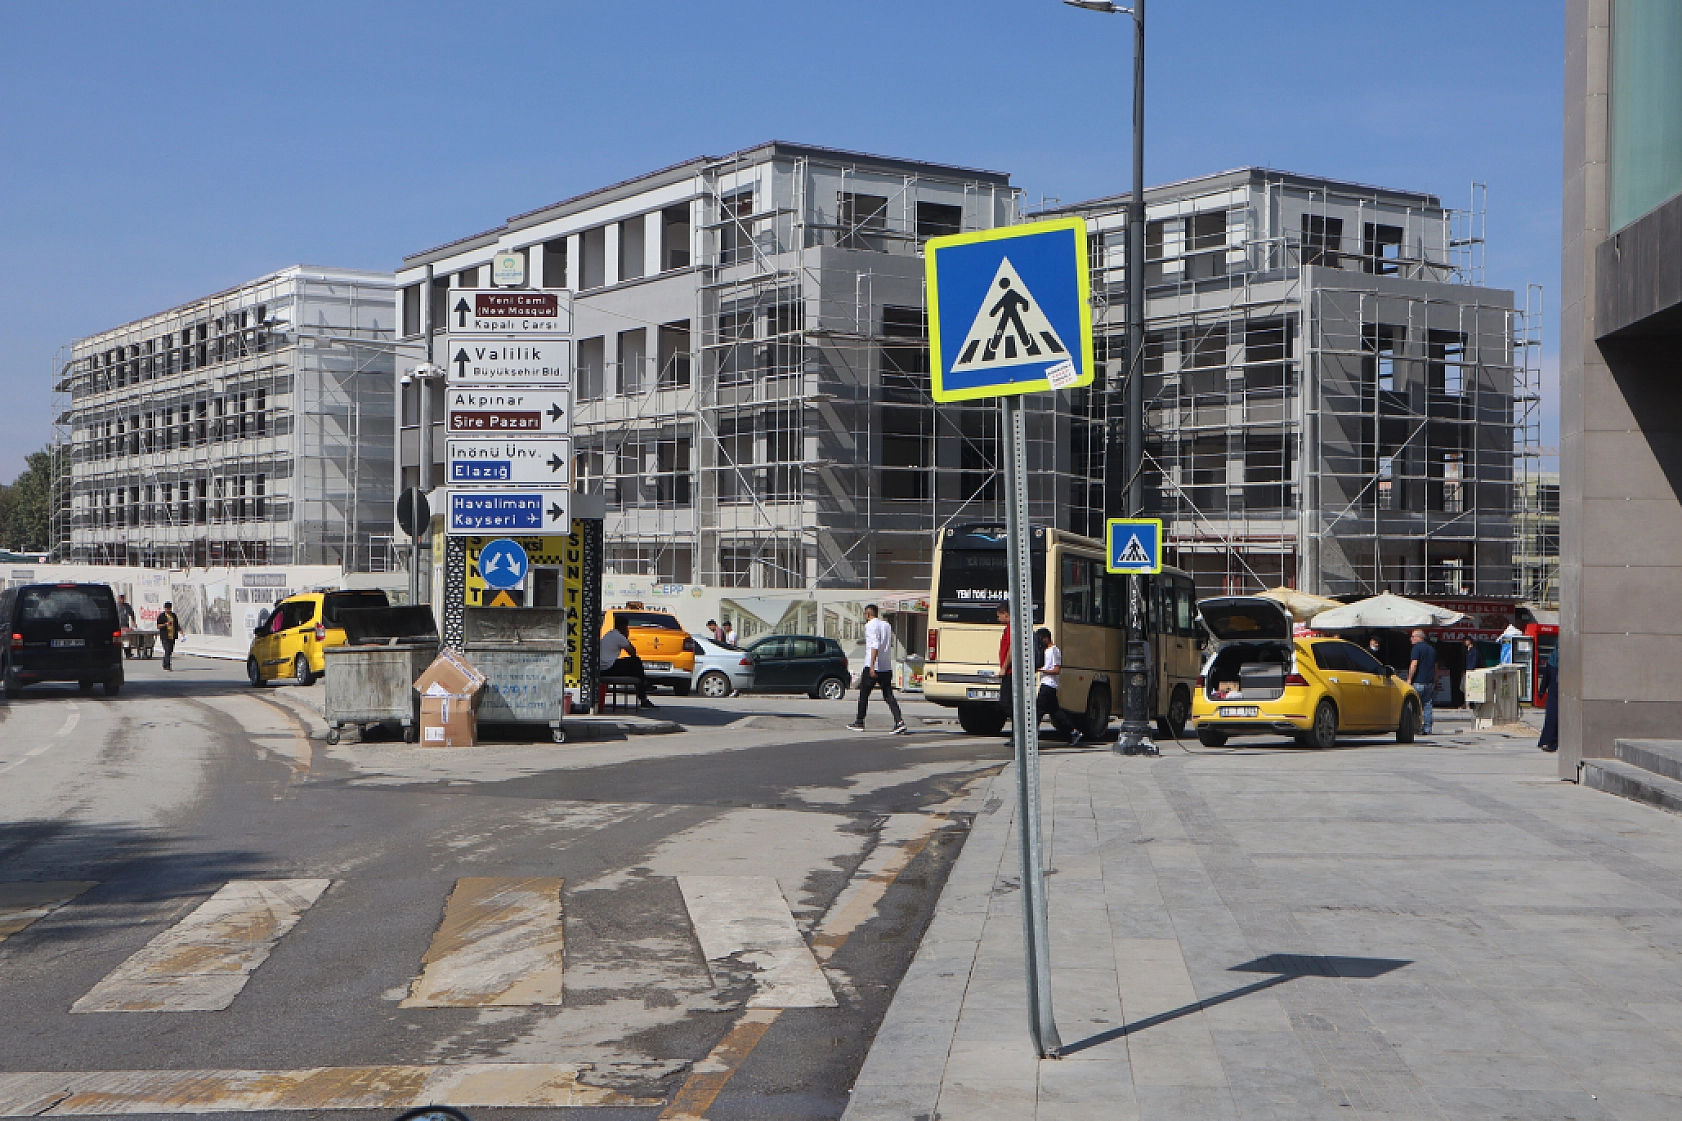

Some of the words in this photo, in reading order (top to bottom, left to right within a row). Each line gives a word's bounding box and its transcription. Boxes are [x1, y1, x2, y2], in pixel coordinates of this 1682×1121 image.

[488, 295, 514, 305] Yeni
[517, 295, 546, 305] Cami
[507, 306, 556, 317] Mosque)
[475, 319, 514, 330] Kapalı
[475, 347, 541, 360] Valilik
[542, 367, 562, 377] Bld.
[455, 393, 523, 407] Akpınar
[453, 414, 484, 428] Şire
[489, 415, 539, 428] Pazarı
[451, 443, 499, 458] İnönü
[506, 443, 542, 458] Ünv.
[455, 465, 508, 480] Elazığ
[454, 497, 540, 509] Havalimanı
[455, 514, 516, 527] Kayseri
